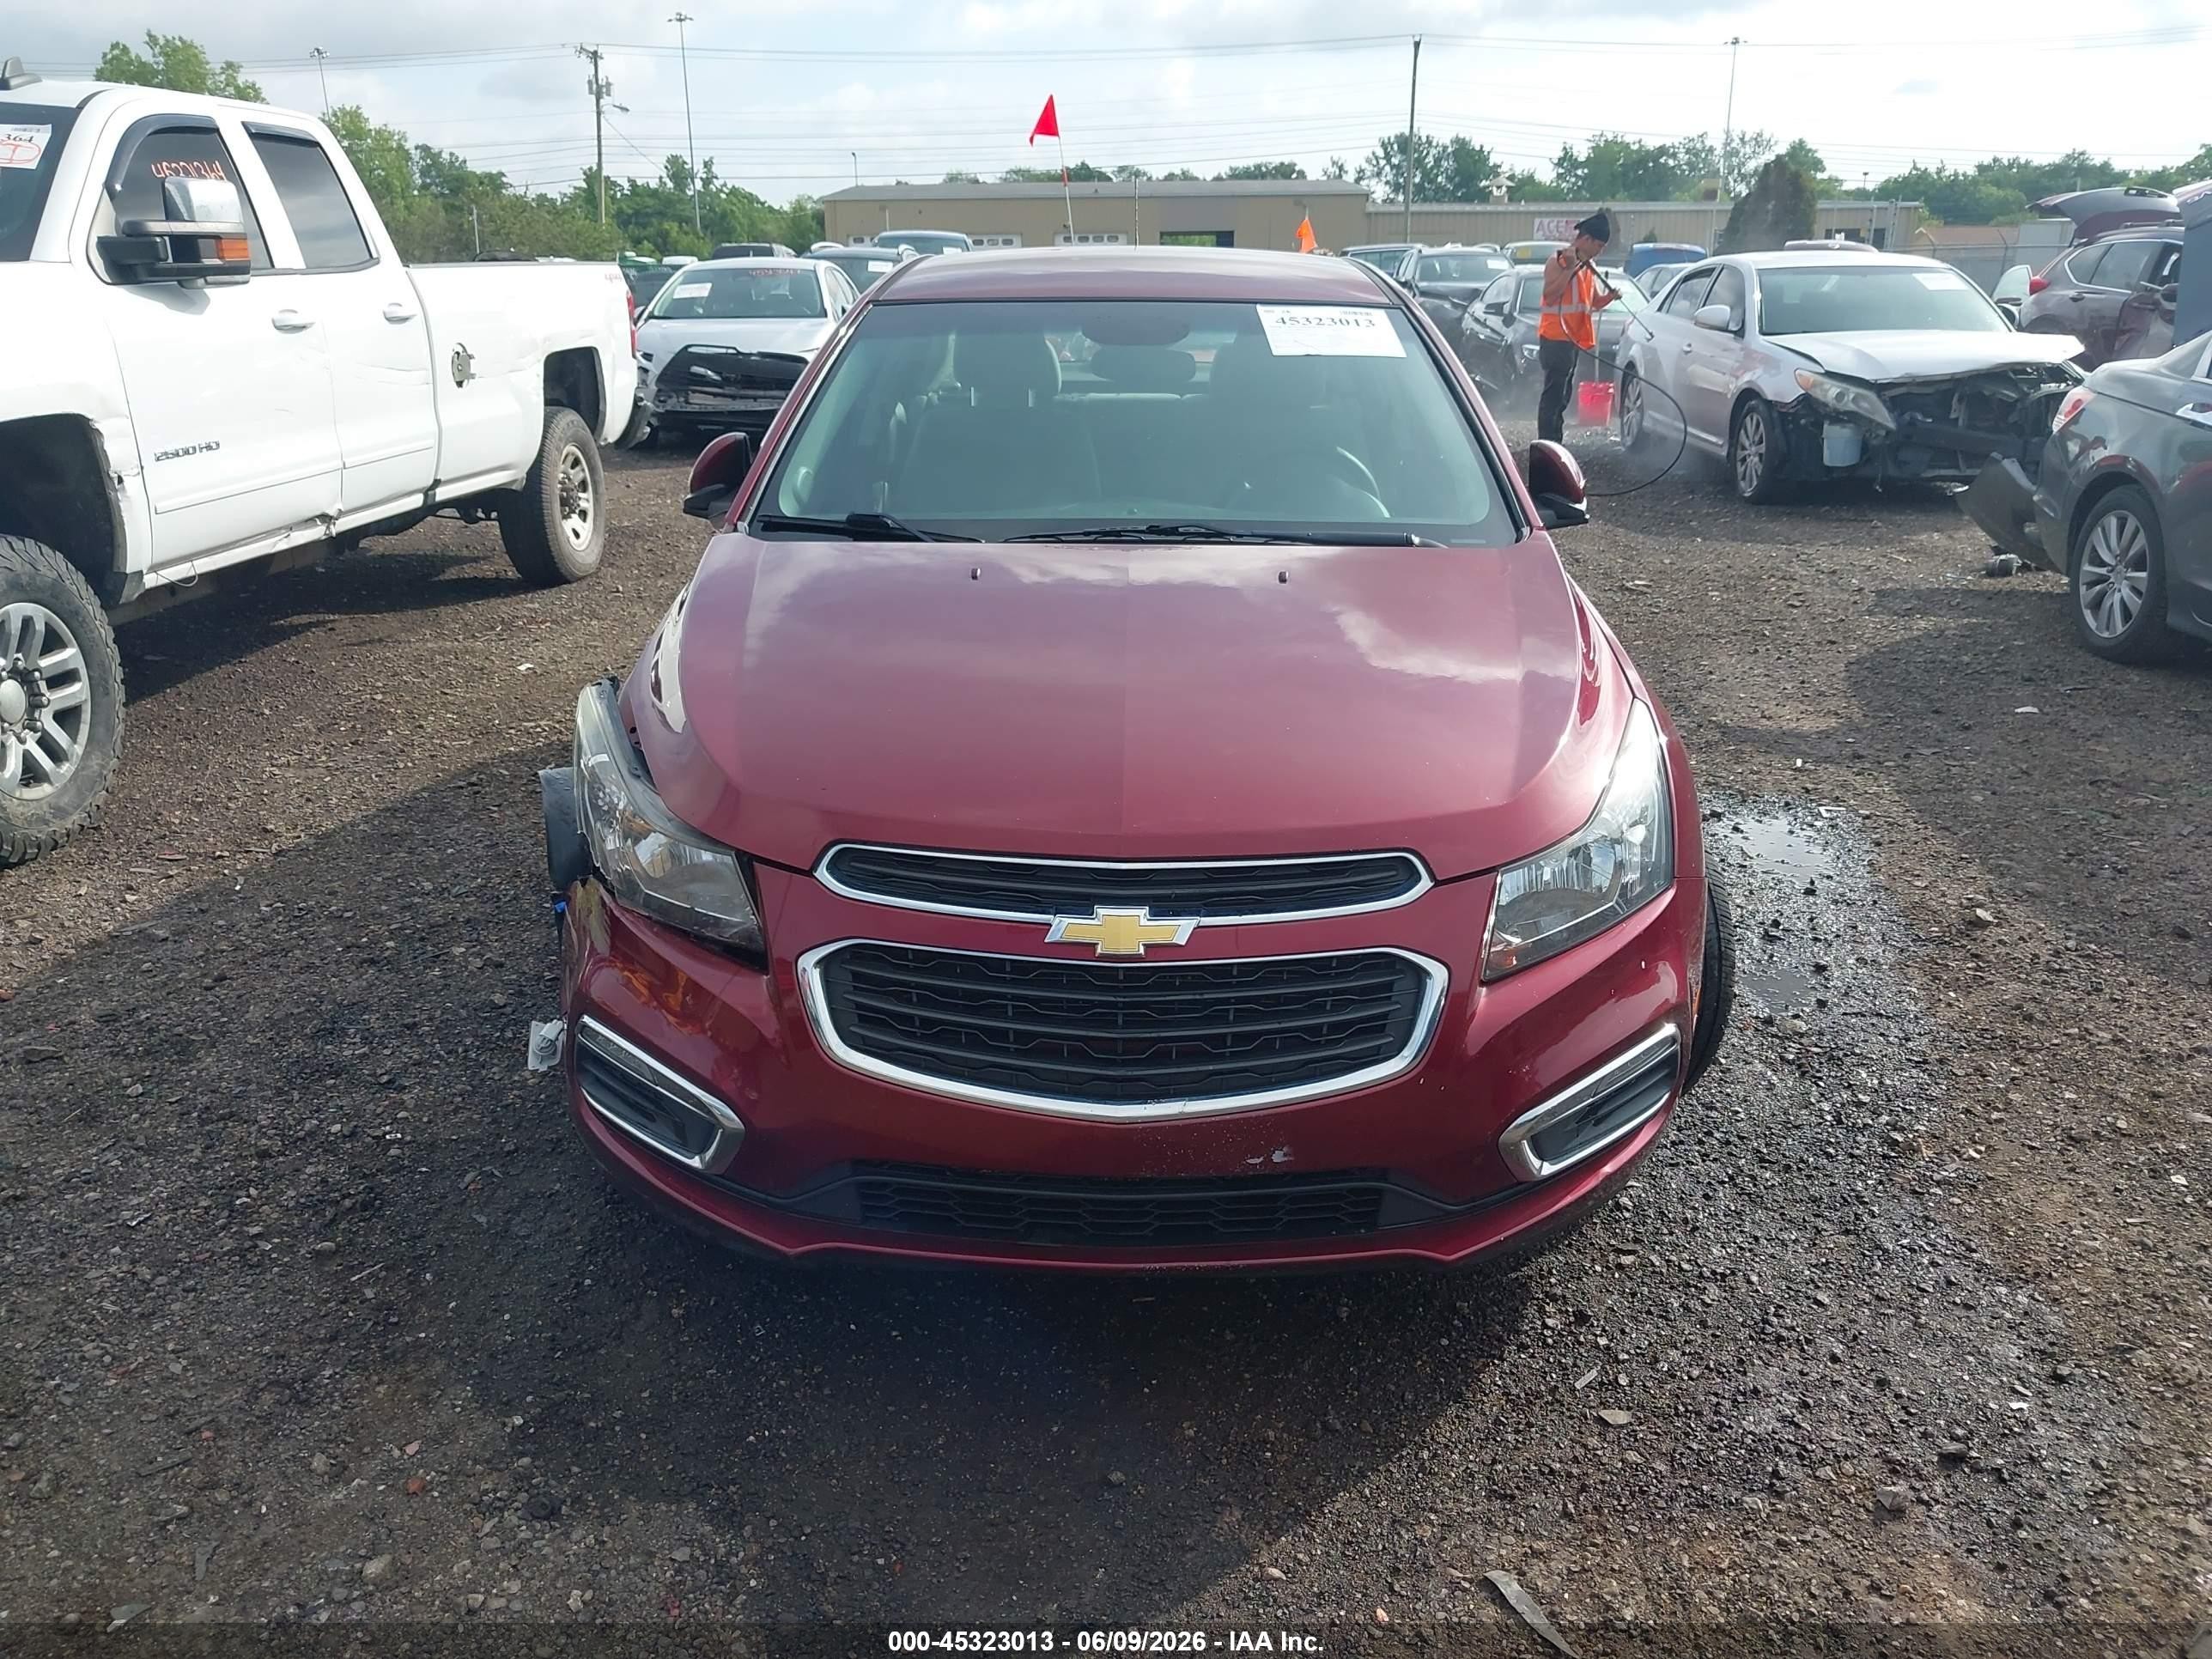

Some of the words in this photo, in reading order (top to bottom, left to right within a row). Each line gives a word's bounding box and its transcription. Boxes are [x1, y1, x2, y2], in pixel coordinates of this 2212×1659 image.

[1274, 316, 1376, 328] 45323013
[154, 445, 197, 462] 2500
[198, 440, 221, 453] HD
